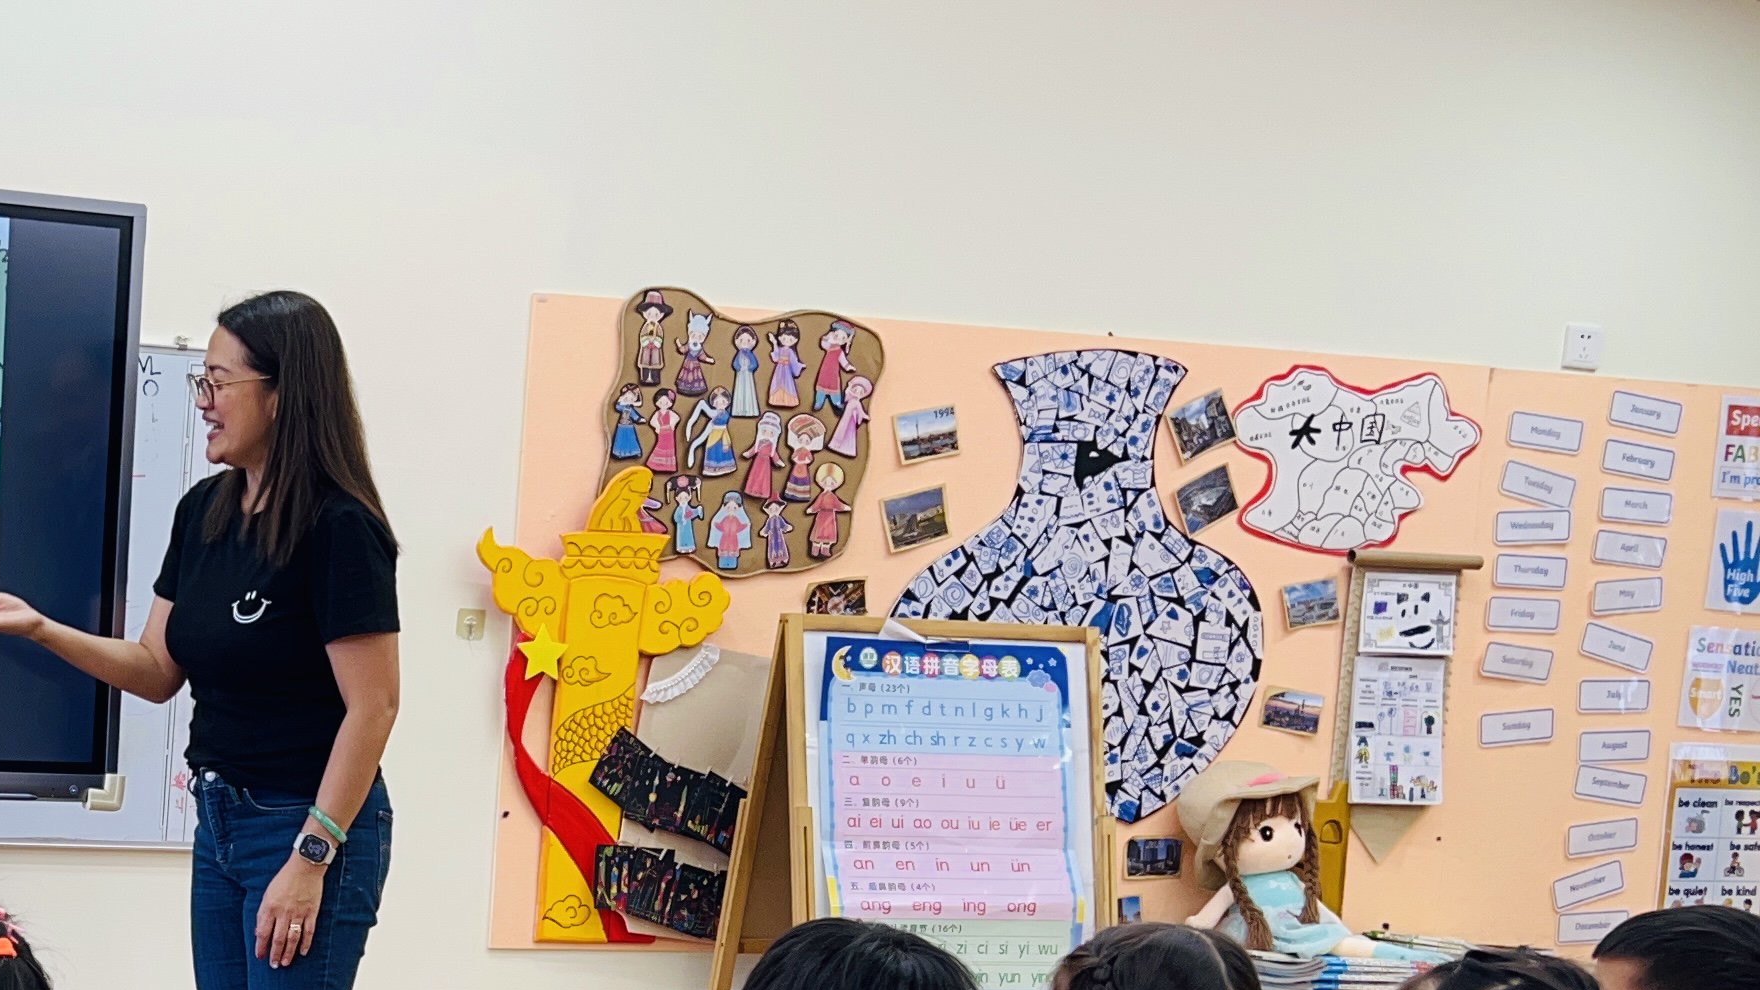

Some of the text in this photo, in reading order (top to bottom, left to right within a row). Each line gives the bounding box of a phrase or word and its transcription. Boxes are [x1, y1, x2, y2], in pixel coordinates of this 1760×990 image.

[1530, 426, 1561, 439] Monday
[1622, 453, 1655, 468] February
[1620, 544, 1639, 553] April
[1514, 565, 1549, 576] Thursday
[1727, 568, 1753, 585] High
[1727, 584, 1750, 597] Five
[1510, 609, 1535, 619] Friday
[884, 655, 1020, 678] 汉语拼音字母表
[1728, 684, 1744, 718] YES
[847, 698, 1043, 722] b p m f d t n l g k h j
[847, 814, 1052, 831] ai ei ui ao ou iu ie üe er
[854, 858, 1030, 872] an en in un ün
[861, 899, 1036, 916] ang eng ing ong
